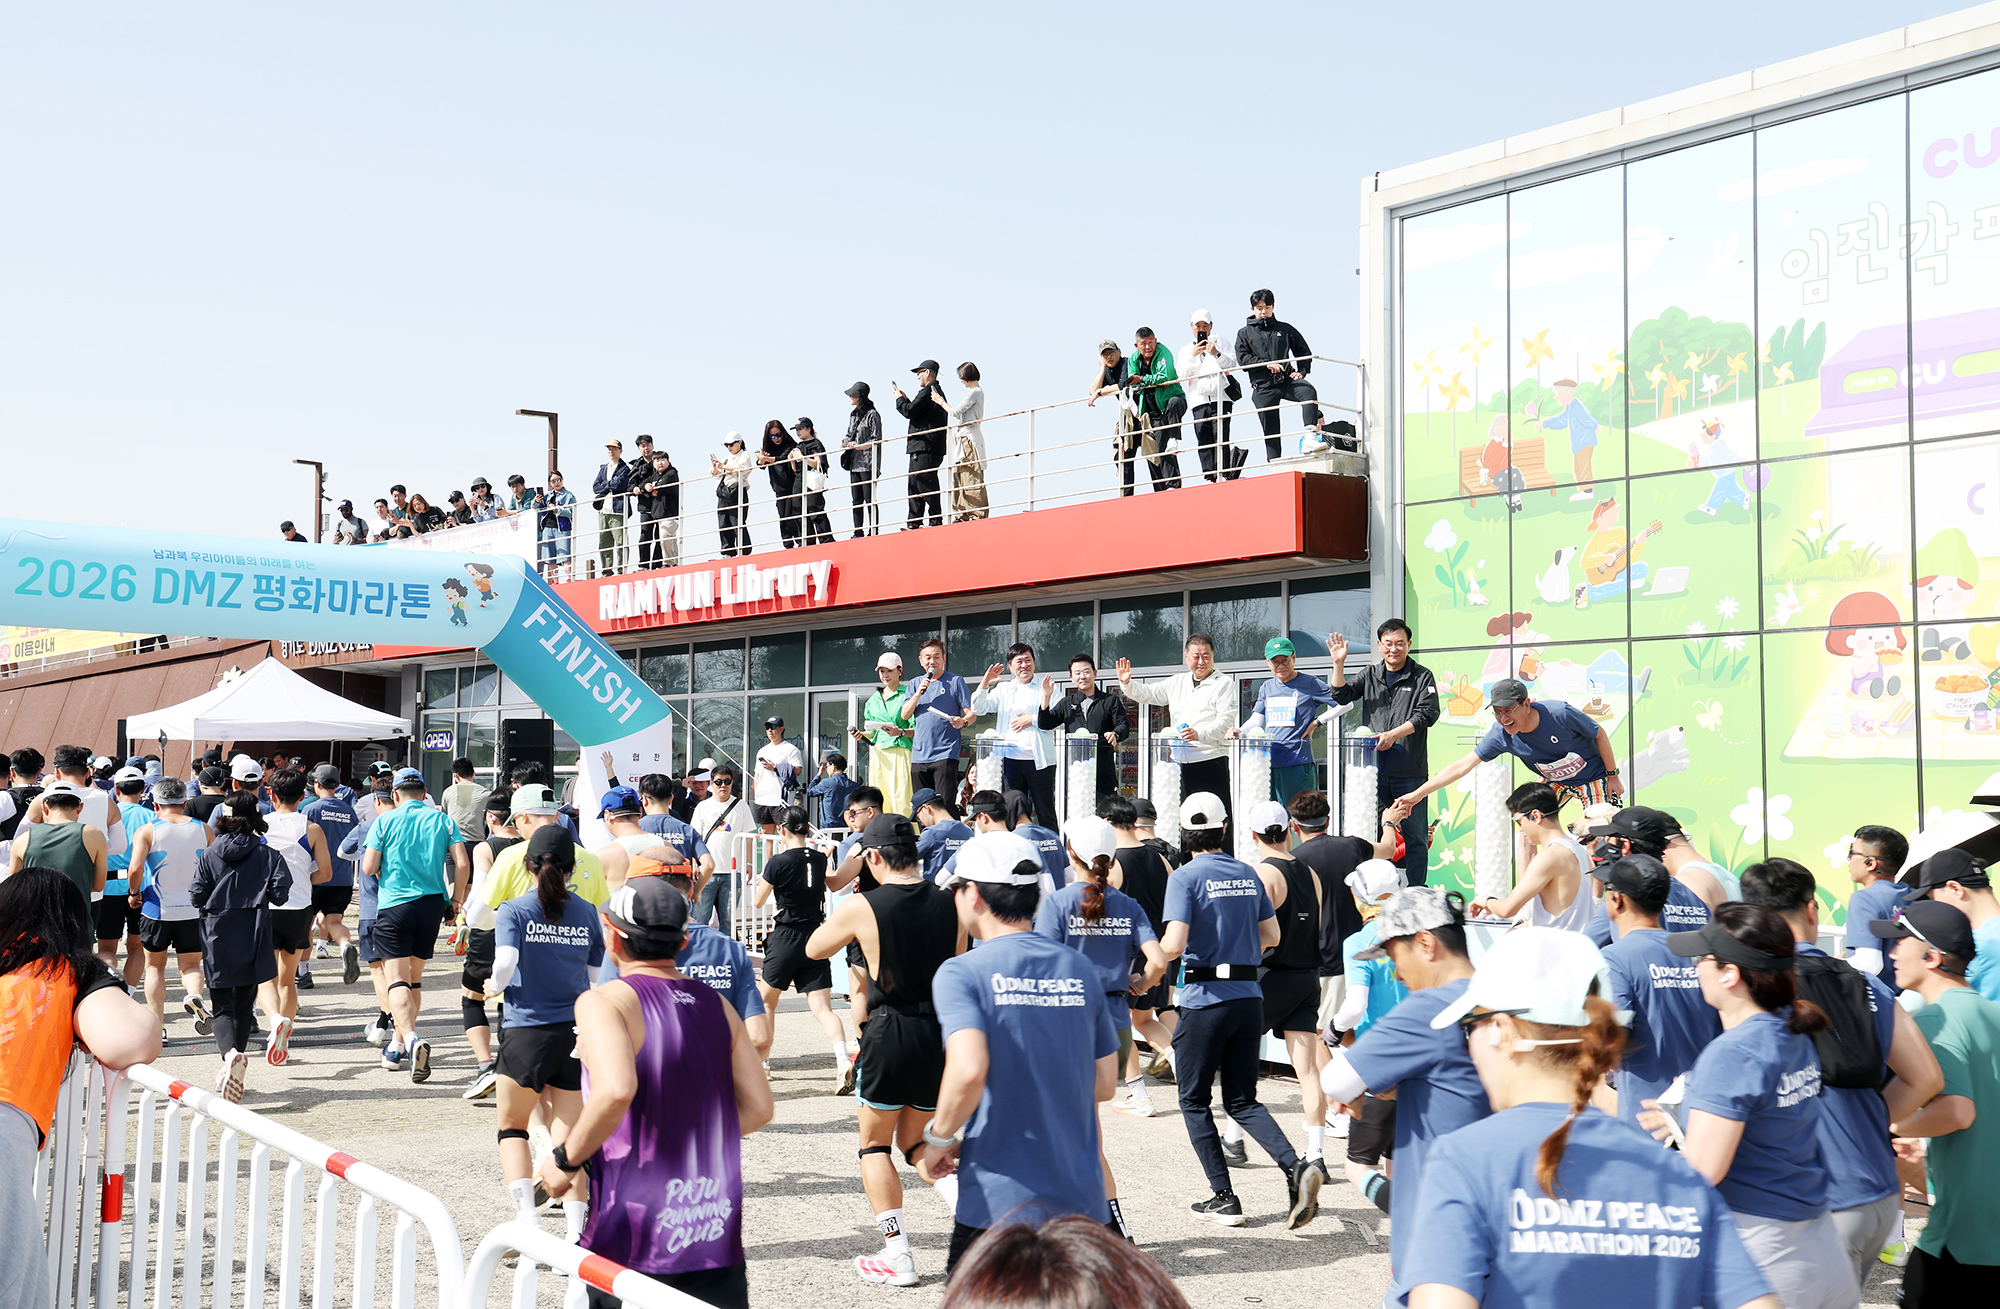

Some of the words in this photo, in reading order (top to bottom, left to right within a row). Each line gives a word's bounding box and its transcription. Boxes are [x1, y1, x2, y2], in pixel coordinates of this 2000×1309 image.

[1851, 377, 1876, 389] Nice
[1877, 375, 1890, 385] to
[153, 549, 188, 561] 남과북
[190, 552, 257, 566] 우리아이들의
[260, 557, 292, 569] 미래를
[295, 559, 316, 570] 여는
[14, 557, 137, 602] 2026
[152, 567, 244, 609] DMZ
[253, 574, 431, 619] 평화마라톤
[599, 570, 716, 620] RAMYUN
[720, 560, 832, 605] Library
[14, 637, 55, 658] 이용안내
[522, 602, 643, 725] FINISH
[1267, 711, 1292, 721] 10113
[426, 733, 450, 748] OPEN
[1232, 879, 1257, 889] PEACE
[1207, 890, 1244, 899] MARATHON
[1099, 917, 1132, 927] PEACE
[558, 925, 590, 937] PEACE
[1068, 927, 1112, 936] MARATHON
[525, 934, 570, 945] MARATHON
[571, 937, 590, 946] 2026
[689, 965, 732, 978] PEACE
[708, 979, 731, 989] 2026
[1037, 978, 1085, 993] PEACE
[994, 993, 1060, 1007] MARATHON
[1060, 995, 1086, 1007] 2026
[665, 1176, 720, 1206] PAJU
[656, 1198, 733, 1234] RUNNING
[1605, 1201, 1703, 1233] PEACE
[666, 1217, 725, 1254] CLUB
[1509, 1231, 1651, 1257] MARATHON
[1650, 1234, 1701, 1259] 2026
